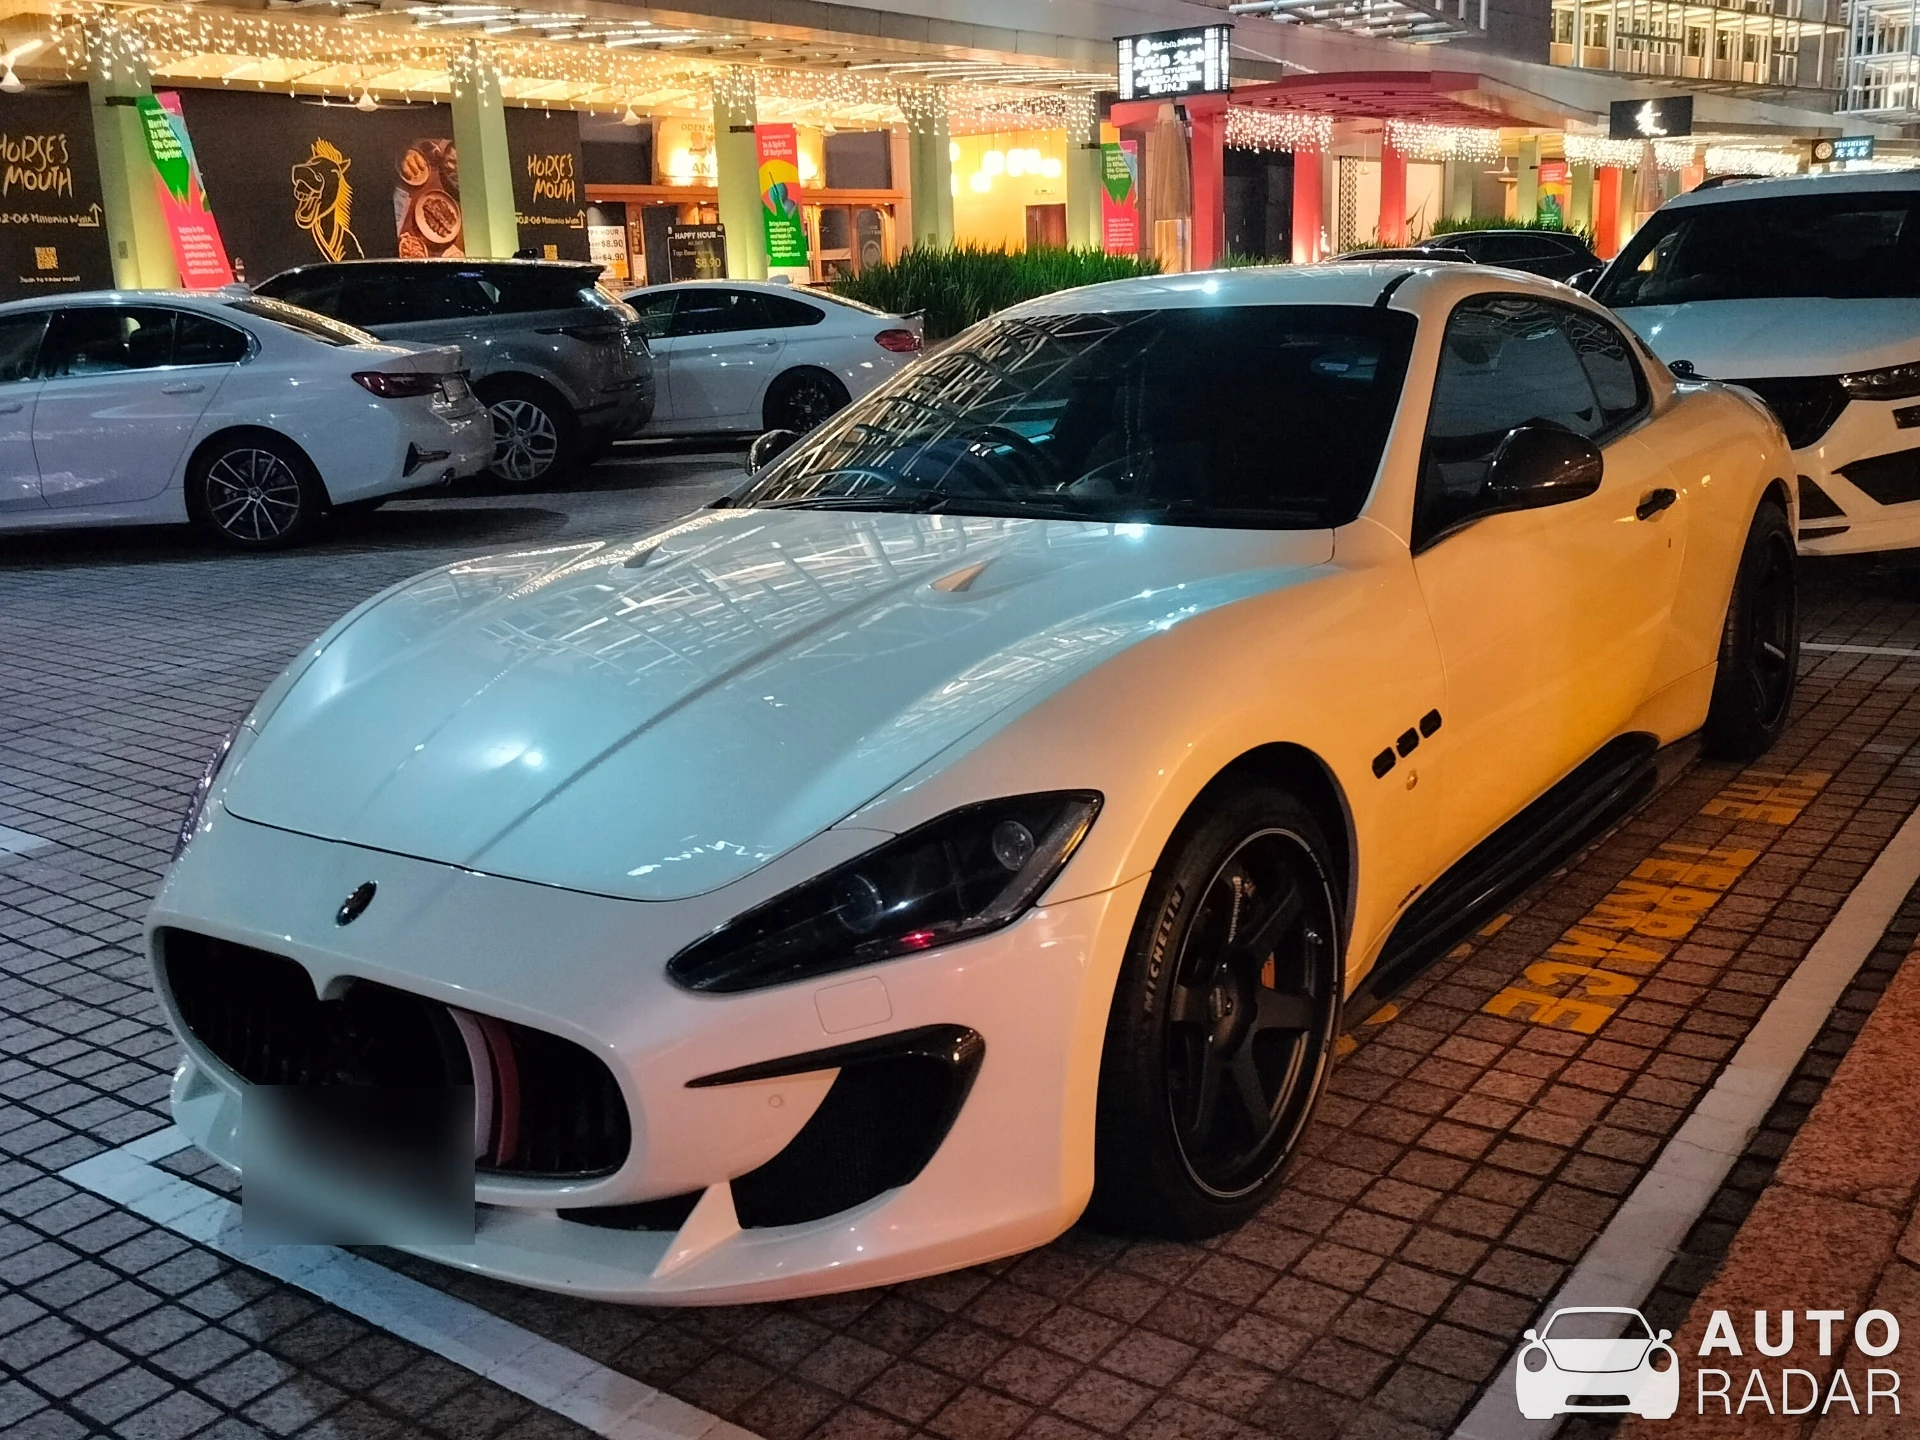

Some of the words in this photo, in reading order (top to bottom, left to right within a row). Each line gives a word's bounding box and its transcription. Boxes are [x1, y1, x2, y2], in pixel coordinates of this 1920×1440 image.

[681, 123, 705, 132] ODEN
[154, 149, 182, 161] Together
[527, 153, 573, 183] HORSE'S
[3, 165, 73, 199] MOUTH
[533, 178, 575, 204] MOUTH
[601, 239, 624, 248] $8.90
[674, 231, 696, 240] HAPPY
[697, 231, 717, 239] HOUR
[602, 253, 625, 261] $4.90
[695, 257, 721, 269] $8.90
[1702, 769, 1833, 826] THE
[1482, 843, 1760, 1035] TERRACE
[1143, 889, 1182, 1013] MICHELIN
